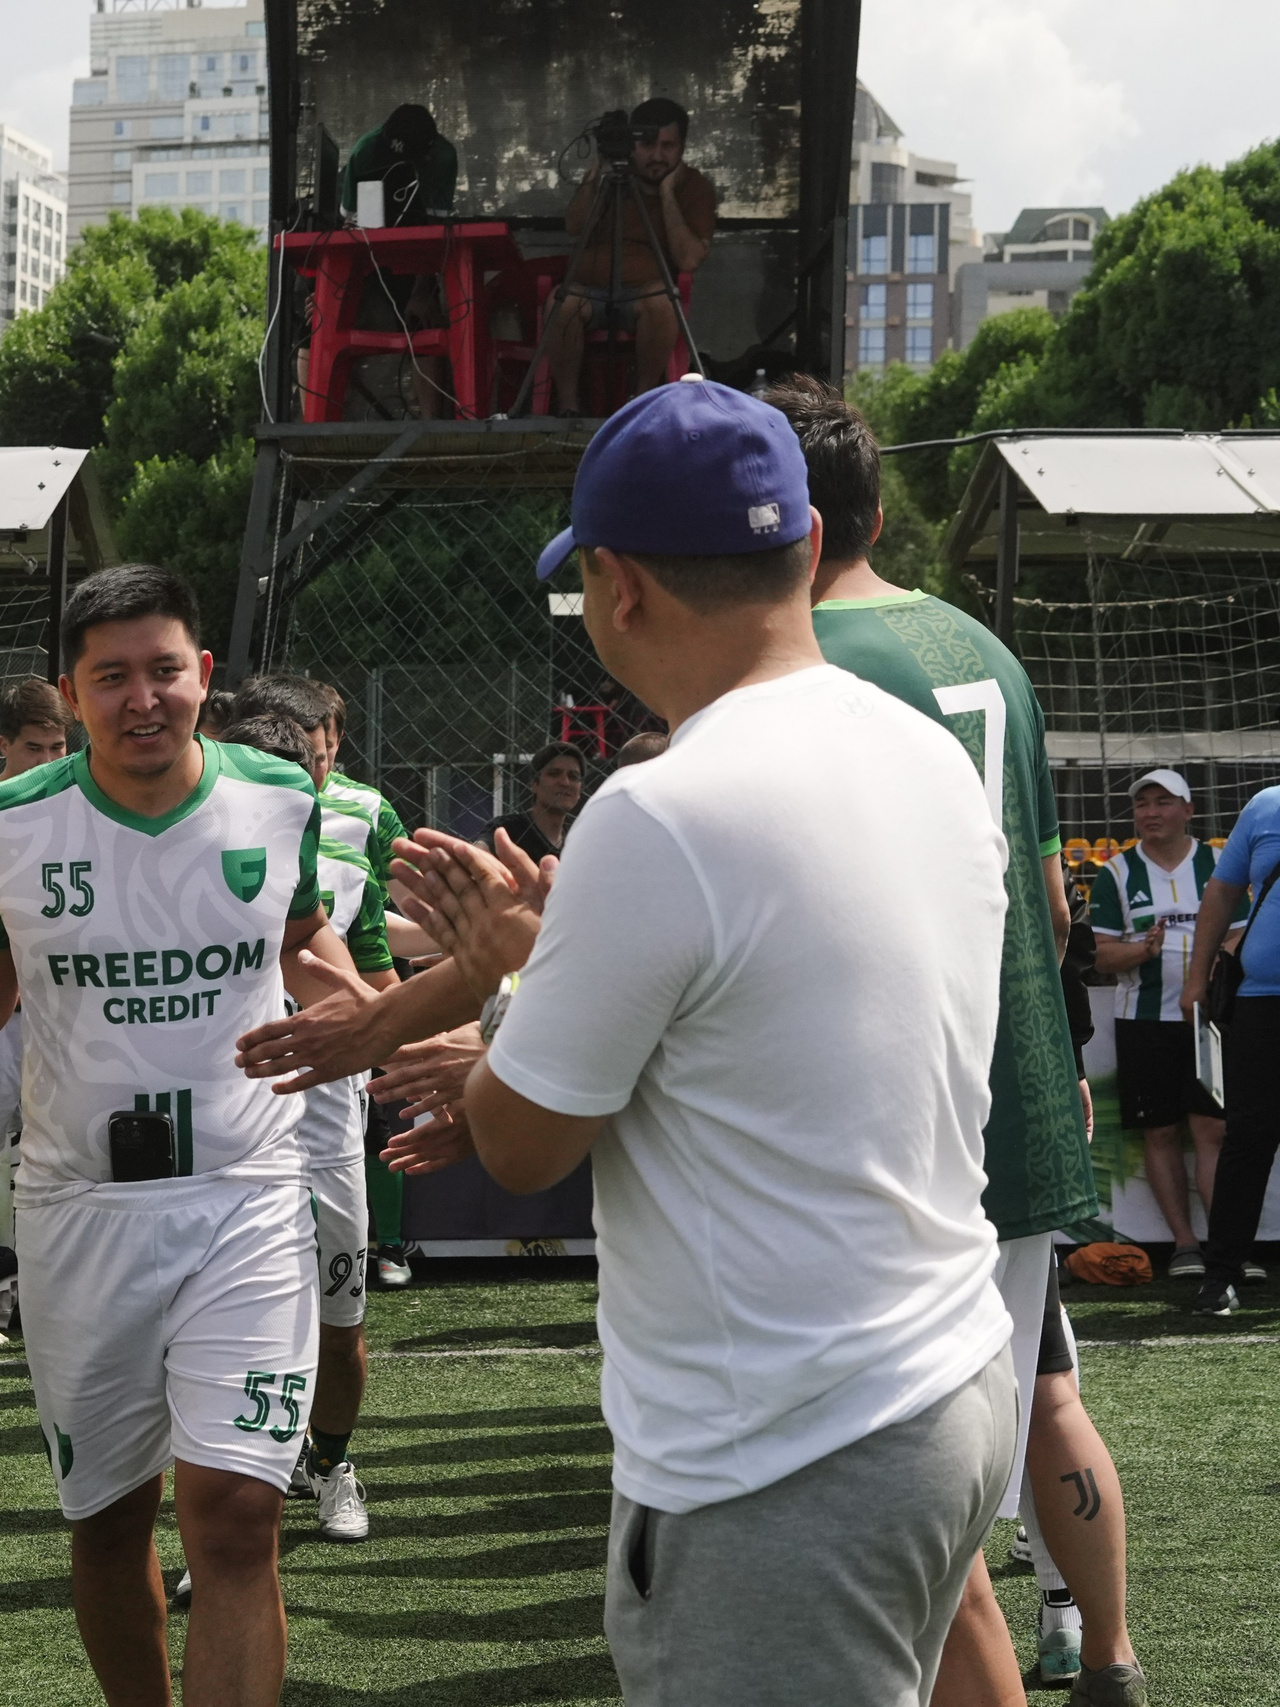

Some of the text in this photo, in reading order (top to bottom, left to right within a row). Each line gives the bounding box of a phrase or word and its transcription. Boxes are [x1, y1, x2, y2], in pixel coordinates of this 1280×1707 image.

[932, 678, 1006, 832] 7
[40, 861, 95, 918] 55
[48, 938, 265, 988] FREEDOM
[103, 989, 222, 1025] CREDIT
[324, 1249, 366, 1298] 93
[234, 1370, 307, 1443] 55
